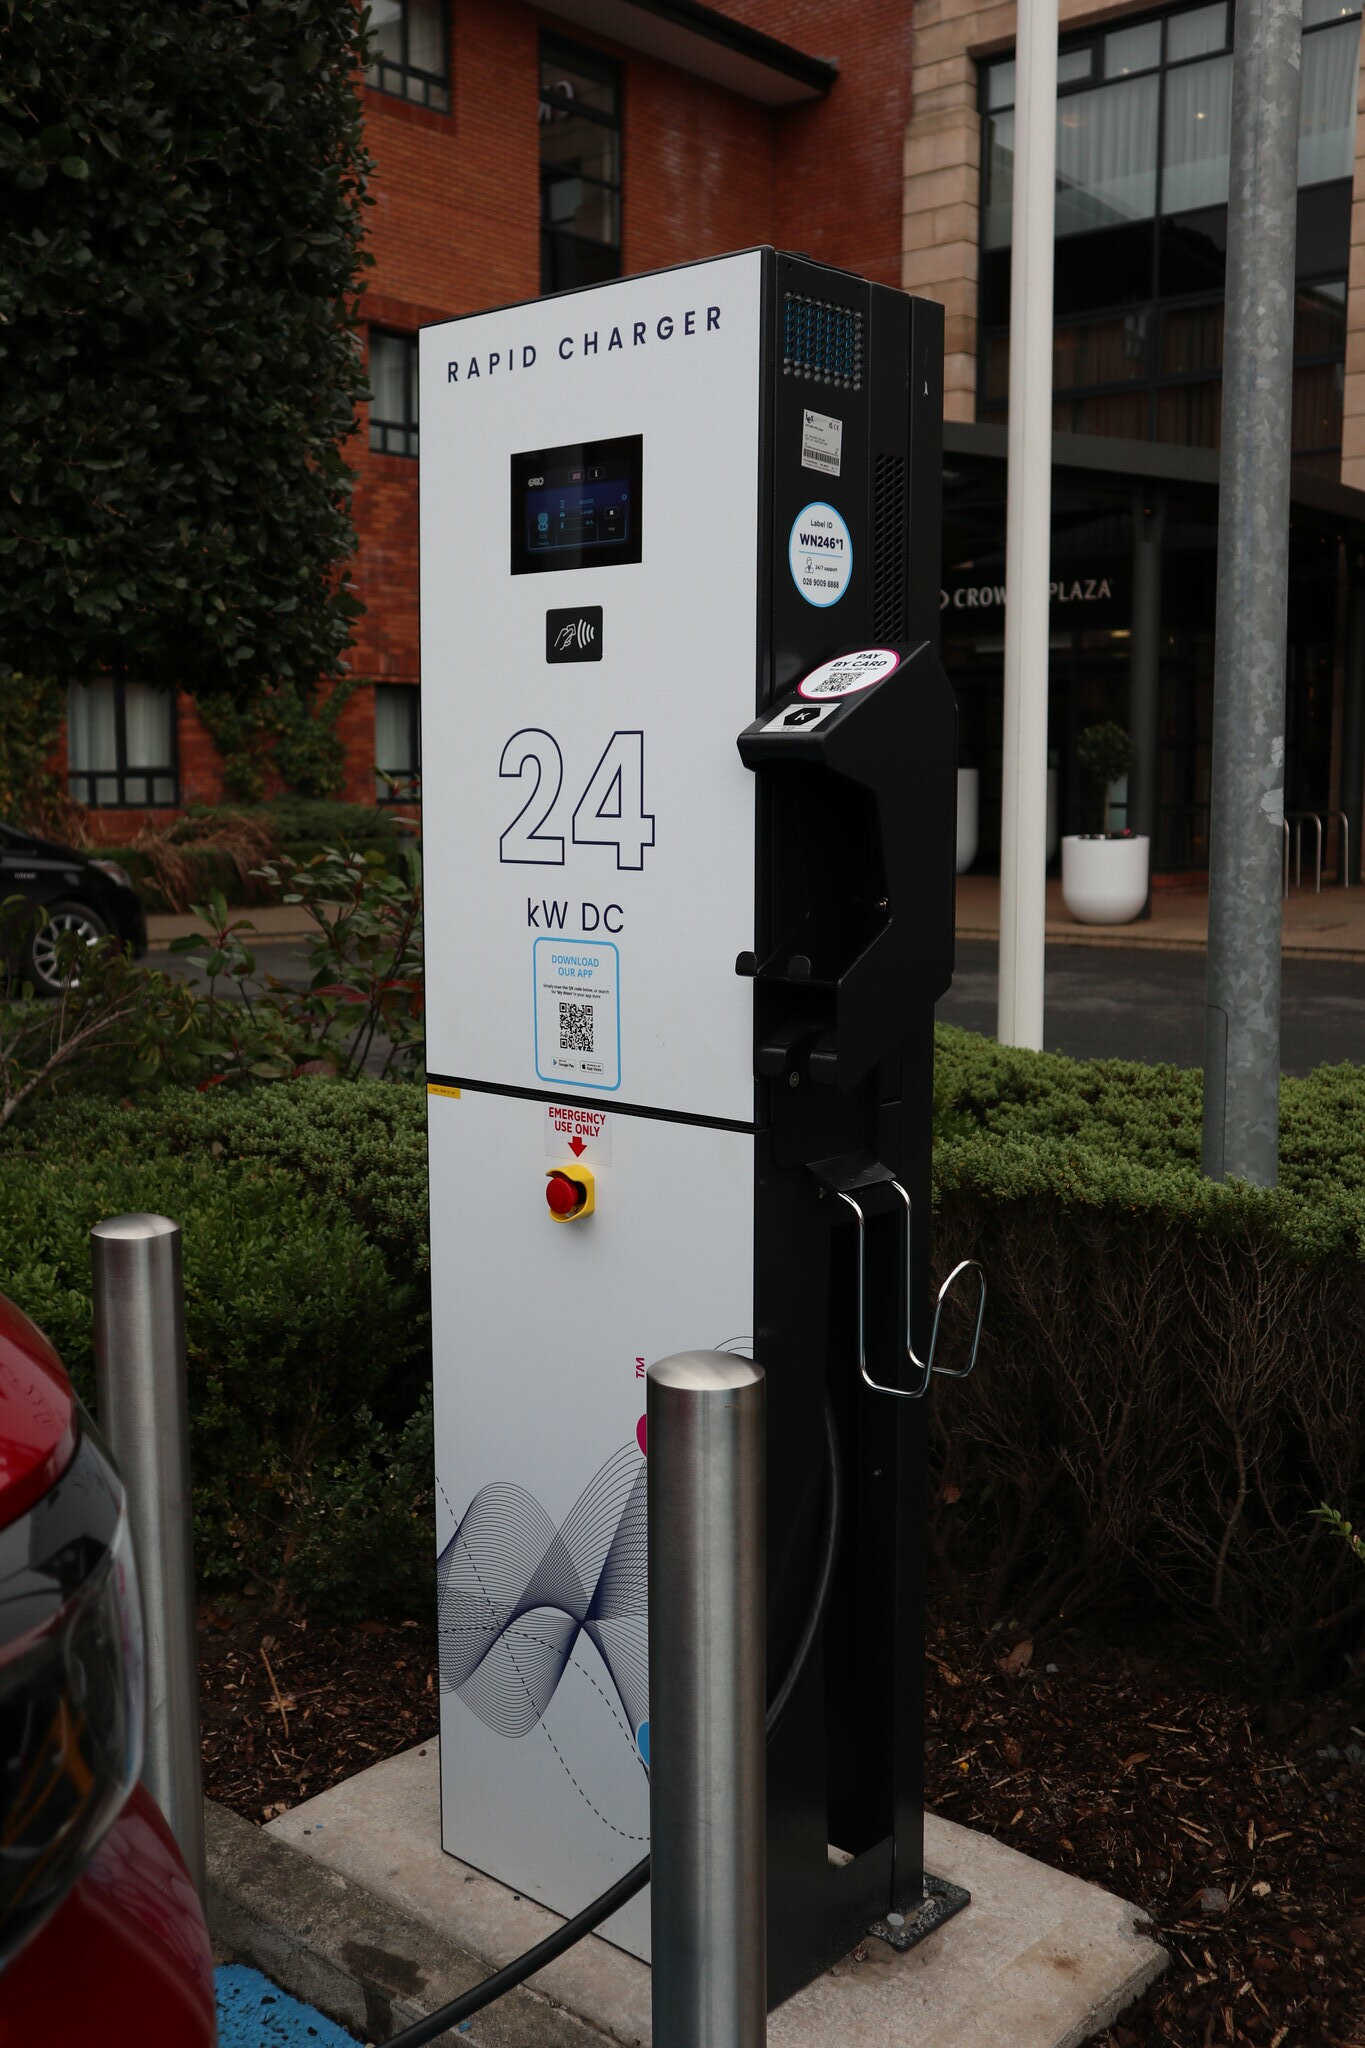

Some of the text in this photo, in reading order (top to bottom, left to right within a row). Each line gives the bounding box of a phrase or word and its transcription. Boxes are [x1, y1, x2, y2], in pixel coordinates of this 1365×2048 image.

[448, 306, 721, 383] RAPID CHARGER
[810, 519, 833, 529] Label ID
[802, 577, 813, 586] 028
[813, 579, 827, 588] 9009
[953, 579, 1112, 608] CROW PLAZA
[794, 712, 811, 721] K
[499, 728, 655, 871] 24
[527, 897, 625, 934] kW DC
[551, 955, 600, 967] DOWNLOAD
[558, 967, 593, 978] OUR APP
[548, 1106, 607, 1126] EMERGENCY
[554, 1119, 601, 1137] USE ONLY
[635, 1357, 645, 1379] TM
